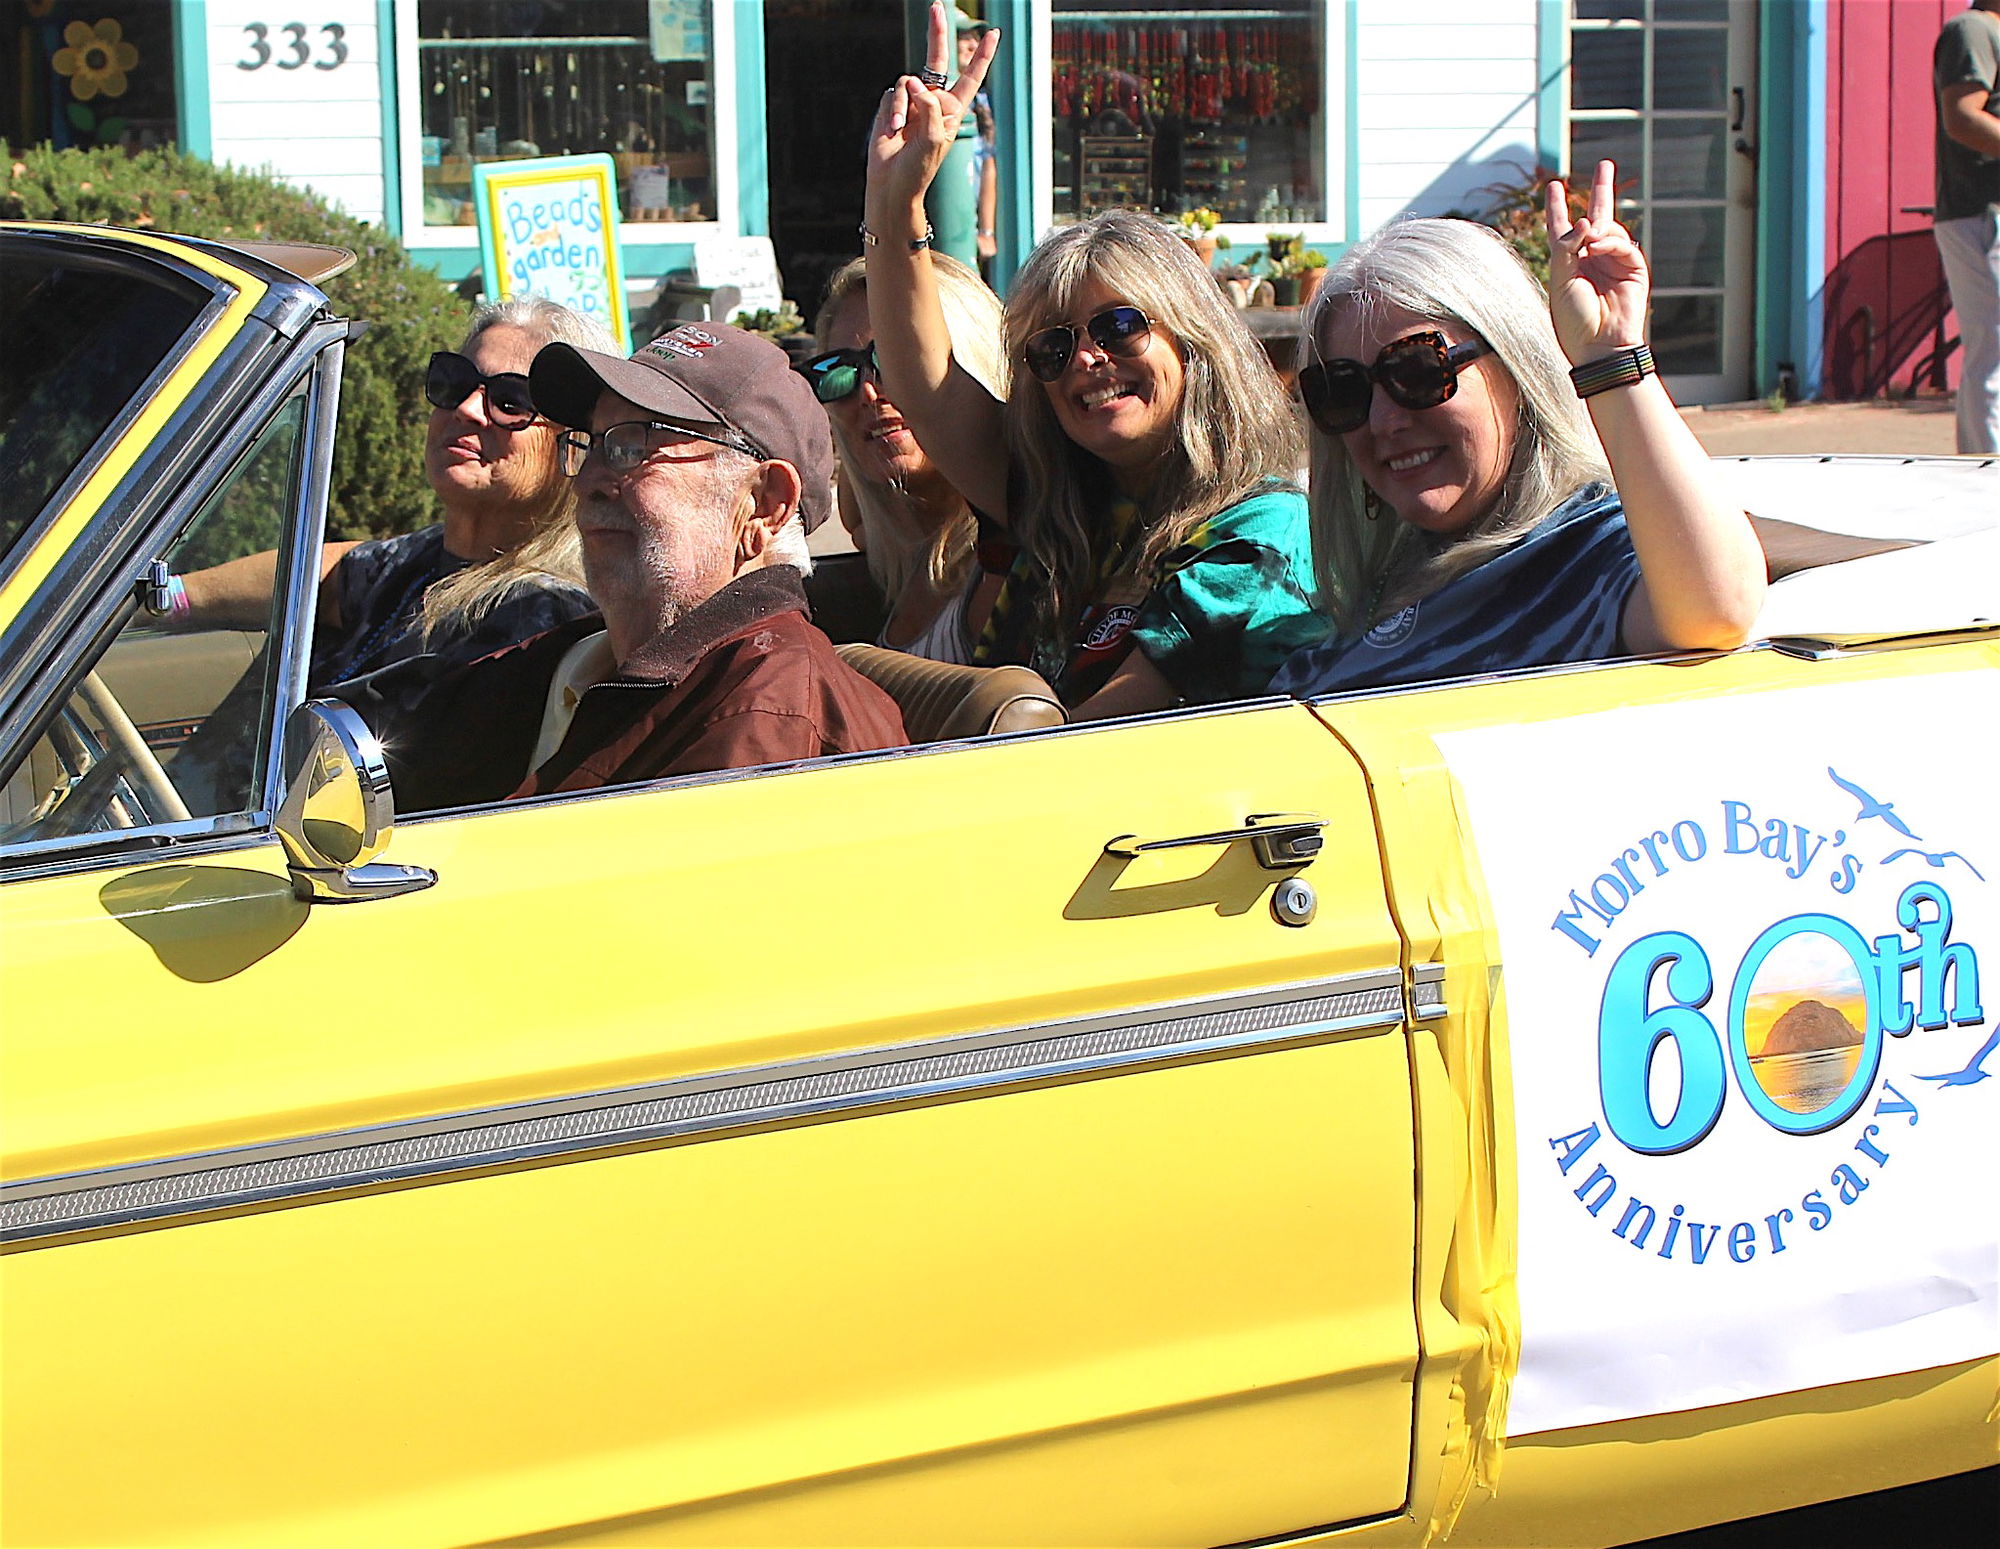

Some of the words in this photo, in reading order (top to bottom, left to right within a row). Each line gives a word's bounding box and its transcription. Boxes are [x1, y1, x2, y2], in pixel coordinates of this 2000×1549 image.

[236, 21, 349, 71] 333
[513, 234, 600, 293] garden
[1551, 819, 1708, 959] Morro
[1720, 799, 1864, 895] Bay's
[1598, 880, 1986, 1157] 60th
[1548, 1078, 1919, 1266] Anniversary
